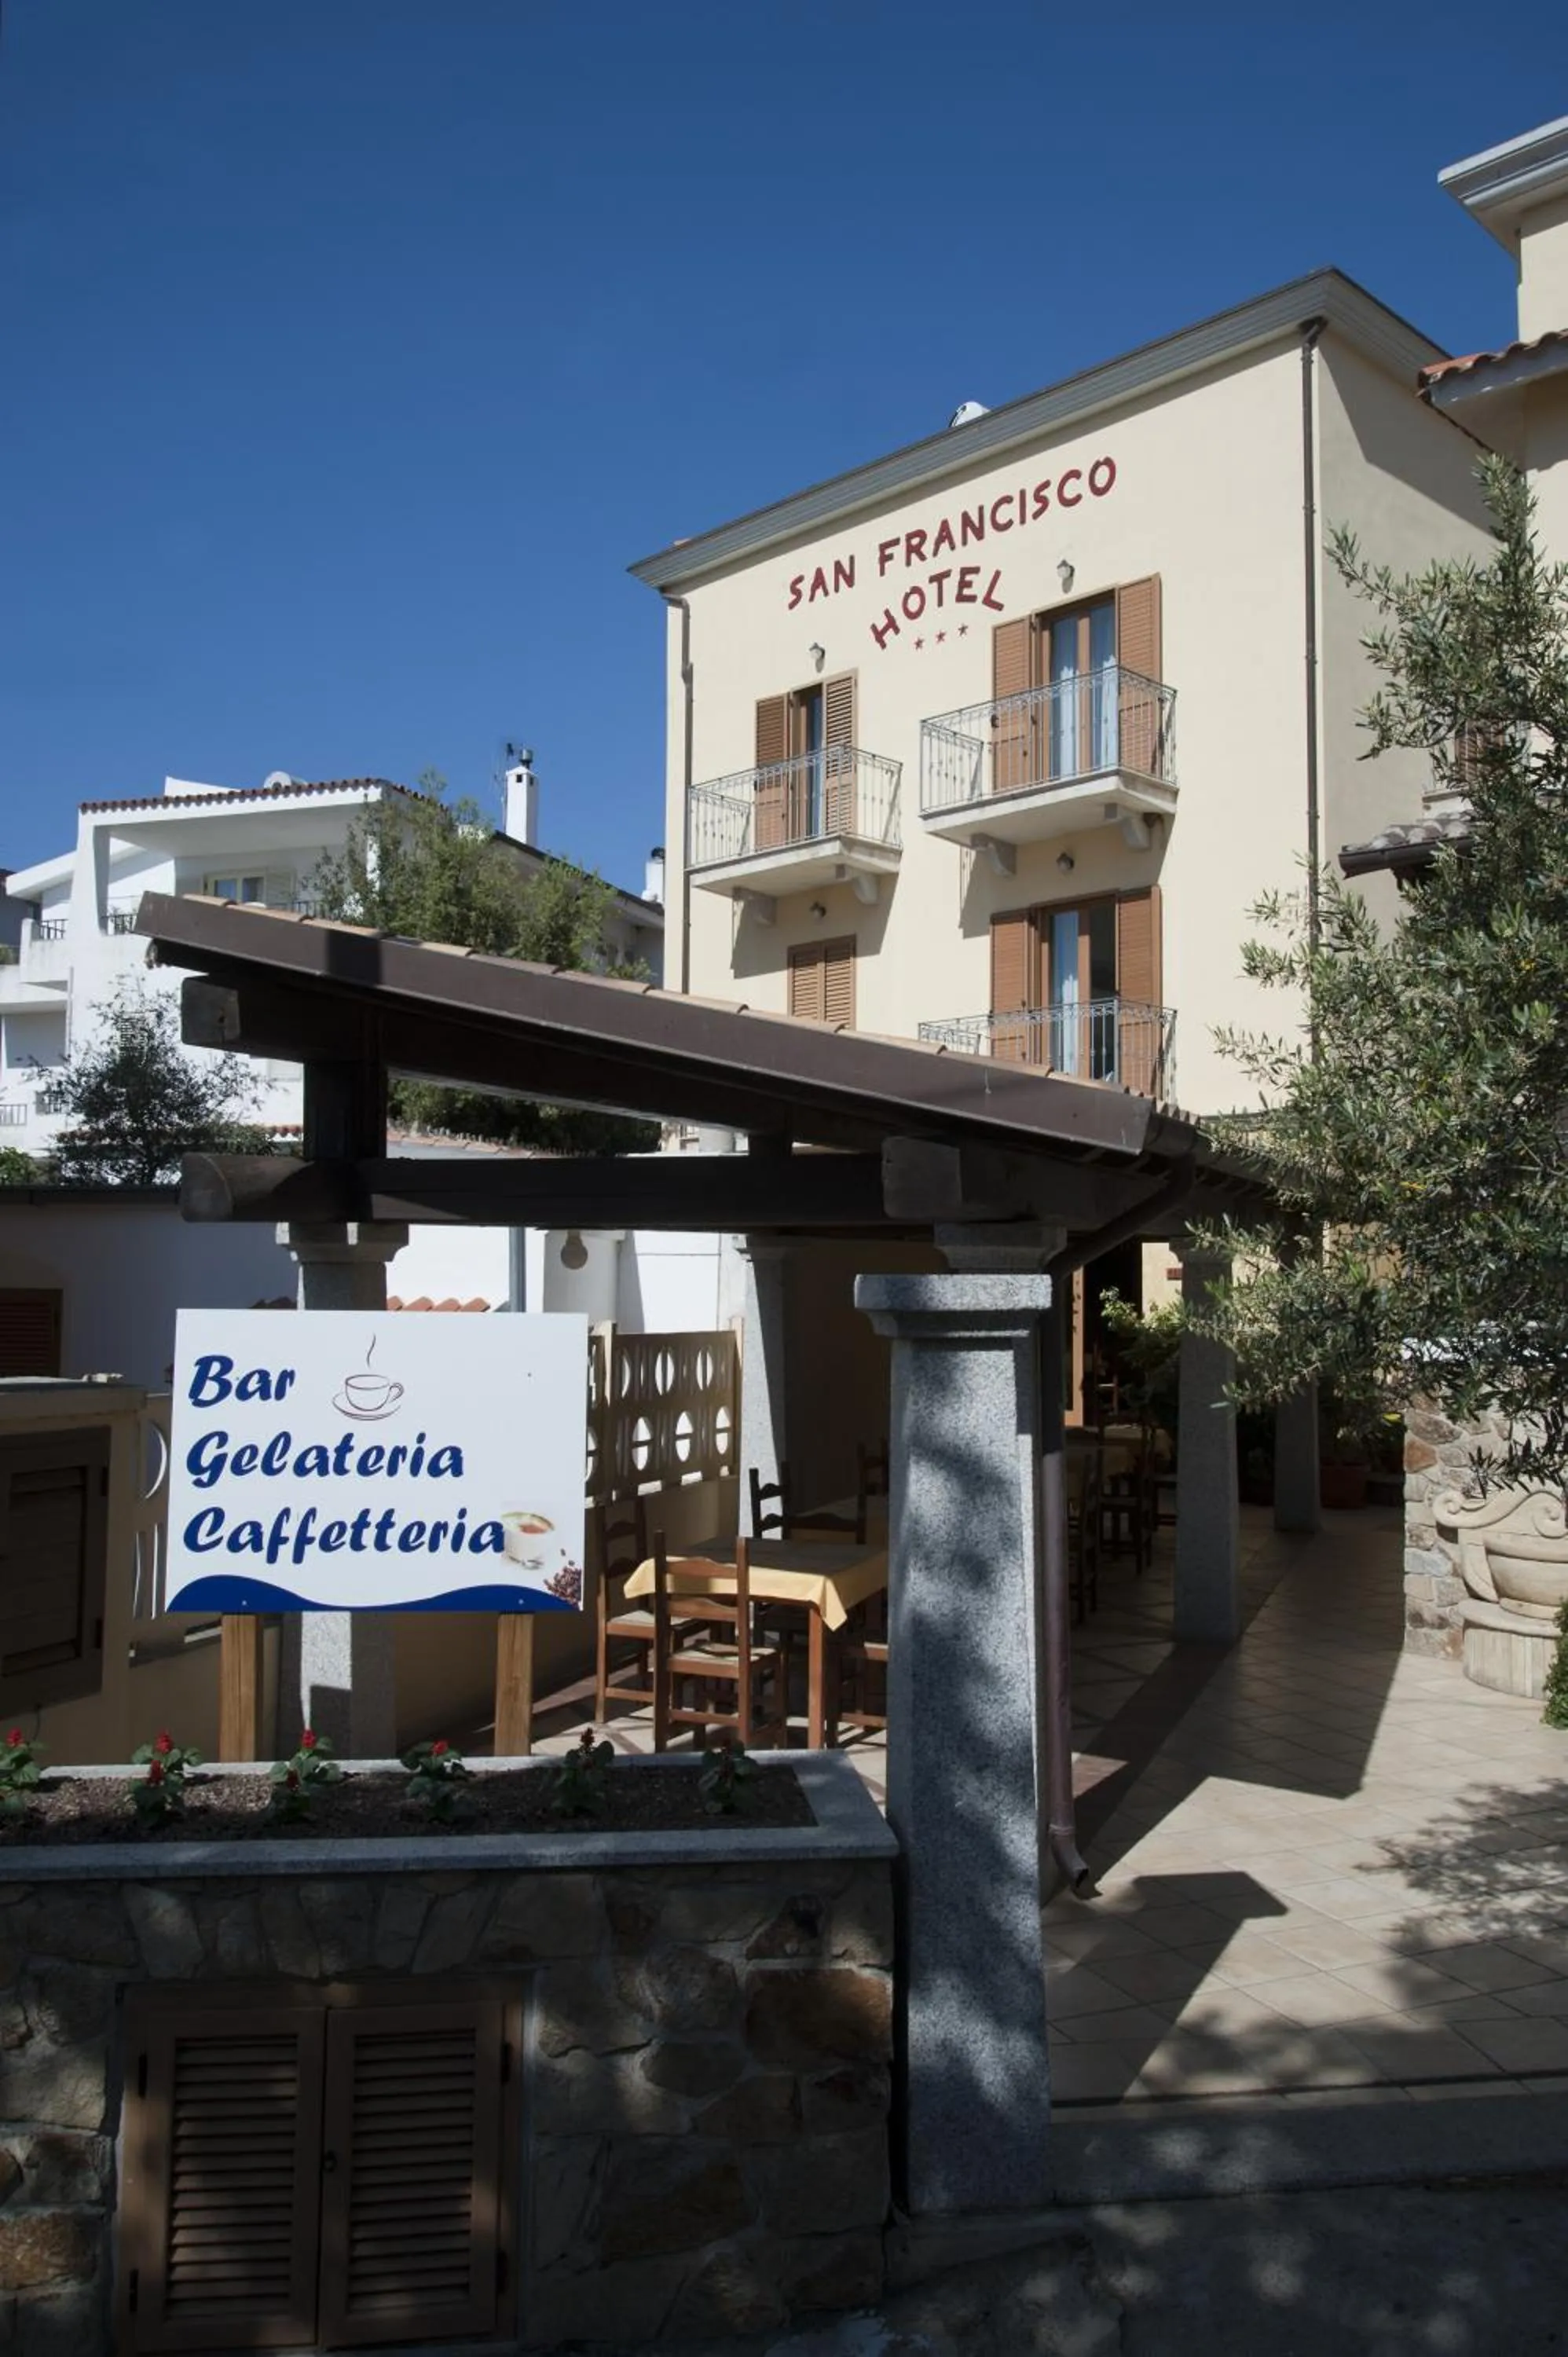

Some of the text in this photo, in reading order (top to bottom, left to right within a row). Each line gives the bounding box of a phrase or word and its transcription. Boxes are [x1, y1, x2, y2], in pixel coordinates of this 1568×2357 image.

[787, 456, 1117, 610] SAN FRANCISCO
[870, 566, 1005, 650] HOTEL
[188, 1354, 295, 1408] Bar
[185, 1430, 465, 1489] Gelateria
[182, 1505, 505, 1565] Caffetteria
